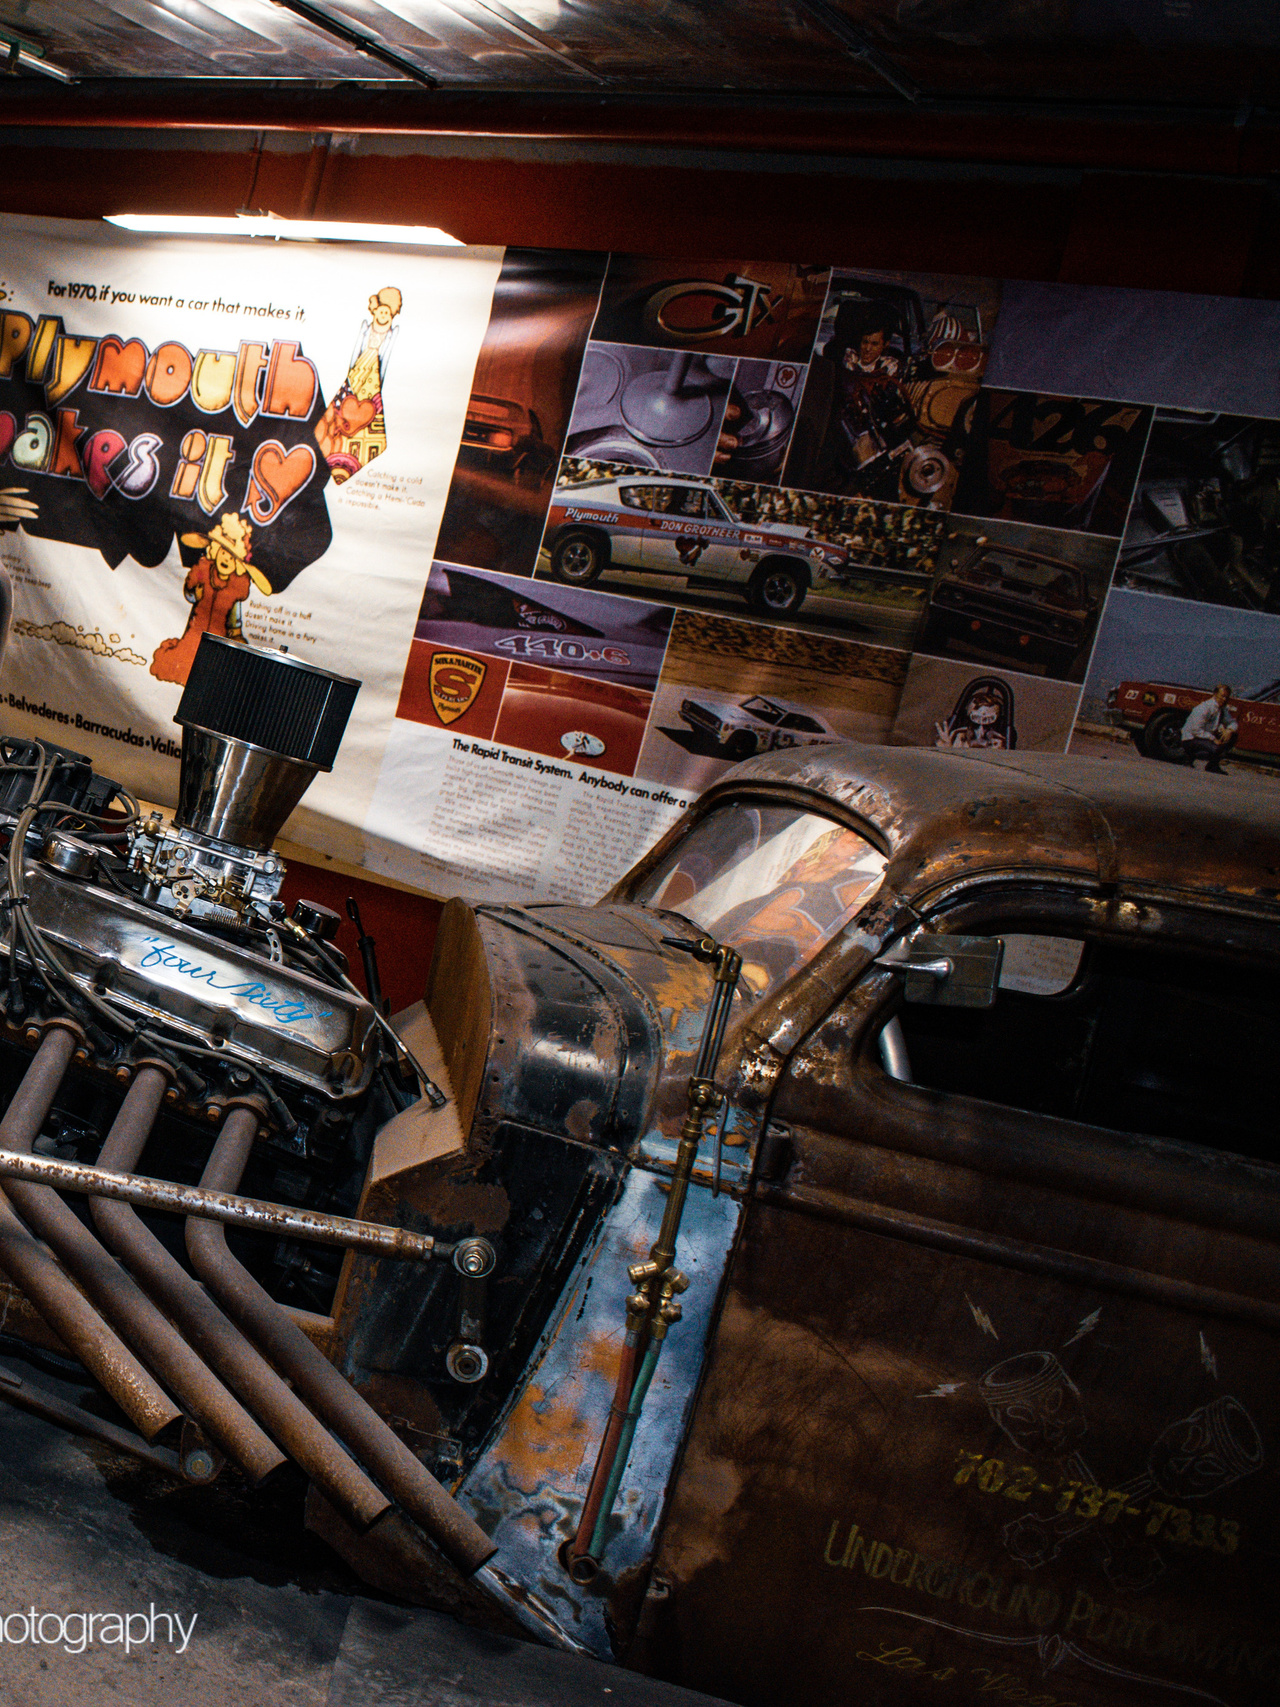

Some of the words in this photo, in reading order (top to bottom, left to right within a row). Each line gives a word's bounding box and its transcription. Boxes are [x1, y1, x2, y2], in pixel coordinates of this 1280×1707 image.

[47, 280, 67, 298] For
[67, 282, 97, 303] 1970,
[98, 284, 111, 301] if
[111, 290, 136, 305] you
[139, 293, 174, 308] want
[175, 299, 184, 308] a
[188, 298, 210, 311] car
[212, 297, 242, 315] that
[243, 303, 291, 321] makes
[169, 429, 236, 517] it
[564, 507, 620, 525] Plymouth
[660, 520, 683, 532] DON
[8, 692, 69, 725] Belvederes
[74, 713, 145, 747] Barracudas
[452, 738, 470, 753] The
[471, 742, 500, 761] Rapid
[501, 751, 534, 768] Transit
[534, 759, 574, 780] System.
[578, 771, 629, 796] Anybody
[630, 785, 650, 799] can
[650, 790, 679, 807] offer
[679, 797, 688, 808] a
